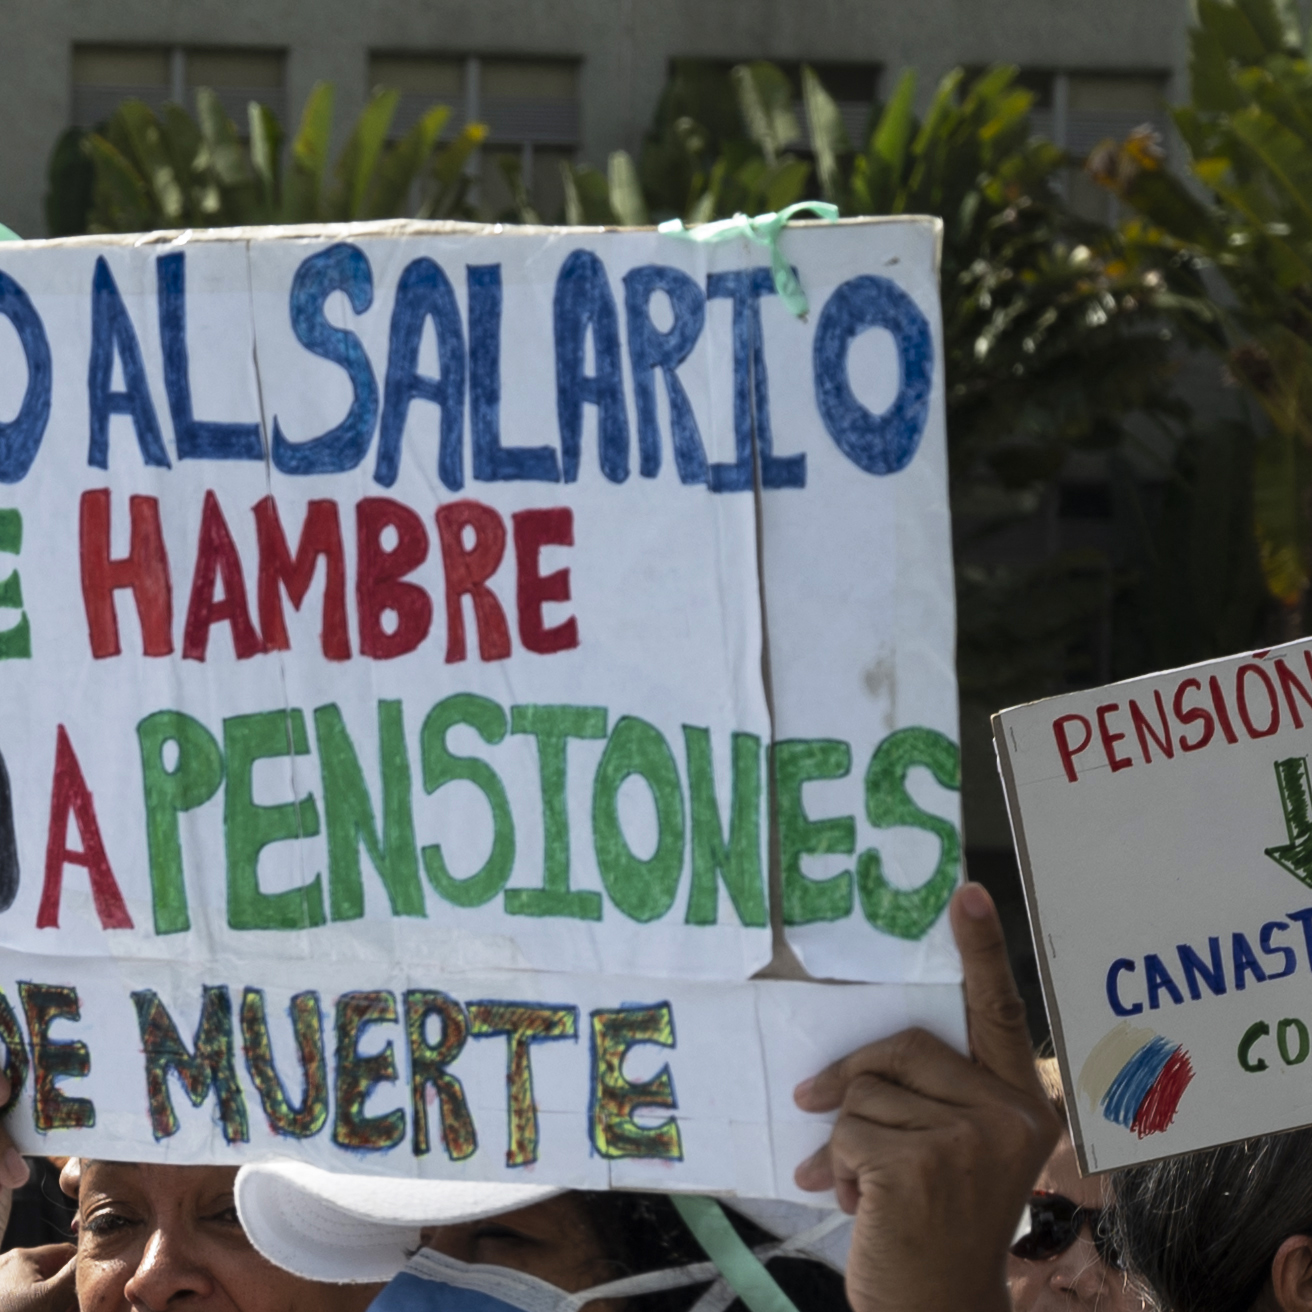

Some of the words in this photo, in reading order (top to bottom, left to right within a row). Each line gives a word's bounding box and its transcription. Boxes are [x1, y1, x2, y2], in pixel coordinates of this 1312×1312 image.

[87, 250, 265, 471] AL
[272, 242, 934, 493] SALARIO
[79, 488, 578, 662] HAMBRE
[37, 722, 132, 930] A
[137, 693, 964, 940] PENSIONES
[131, 982, 683, 1168] MUERTE
